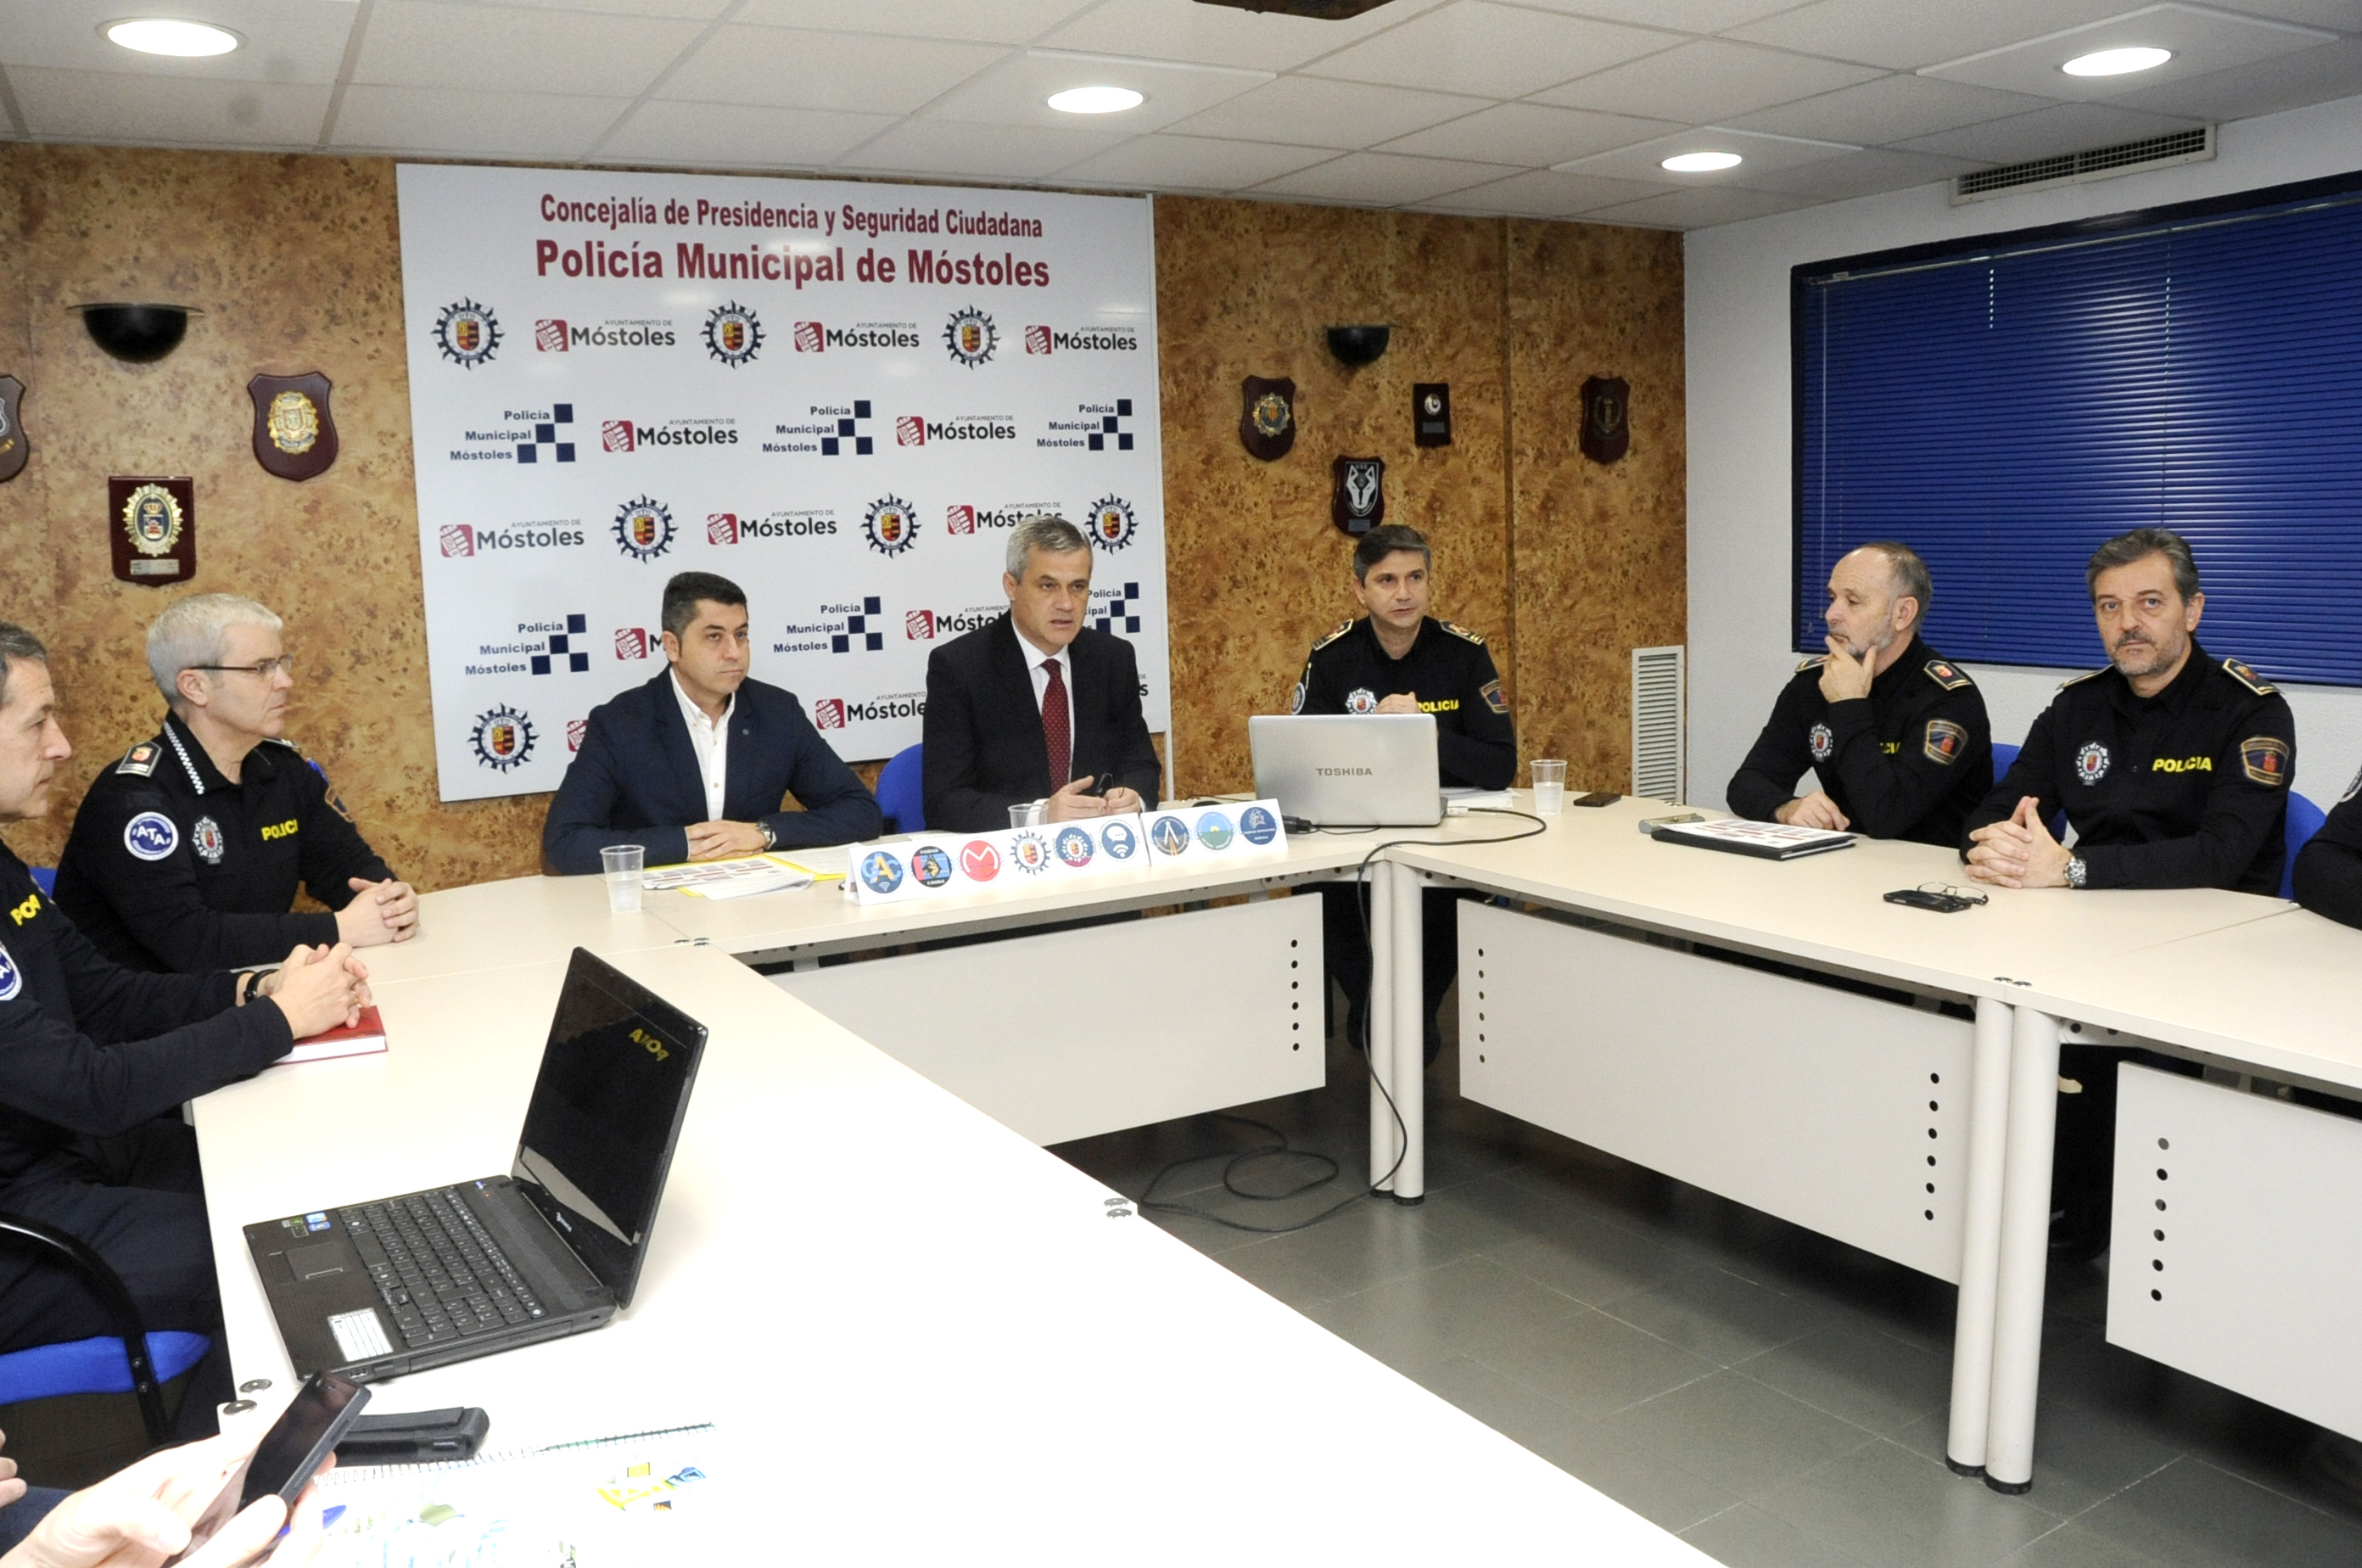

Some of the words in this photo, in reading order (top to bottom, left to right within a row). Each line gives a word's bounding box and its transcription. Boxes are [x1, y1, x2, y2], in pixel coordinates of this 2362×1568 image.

[540, 193, 658, 231] Concejalía
[663, 198, 690, 226] de
[697, 199, 819, 229] Presidencia
[824, 210, 836, 237] y
[842, 204, 940, 238] Seguridad
[945, 209, 1043, 238] Ciudadana
[535, 238, 663, 278] Policía
[676, 242, 844, 290] Municipal
[856, 247, 896, 283] de
[907, 249, 1049, 288] Móstoles
[570, 326, 676, 346] Móstoles
[826, 328, 920, 348] Móstoles
[1053, 332, 1138, 351] Móstoles
[809, 406, 851, 416] Policía
[1078, 404, 1115, 413] Policía
[503, 410, 551, 421] Policía
[775, 423, 835, 436] Municipal
[926, 421, 1016, 440] Móstoles
[1048, 421, 1100, 432] Municipal
[465, 429, 532, 442] Municipal
[636, 425, 739, 446] Móstoles
[762, 442, 818, 453] Móstoles
[1036, 438, 1085, 447] Móstoles
[450, 449, 512, 461] Móstoles
[977, 509, 1063, 529] Móst
[739, 517, 838, 538] Móstoles
[476, 527, 585, 551] Móstoles
[820, 603, 861, 614] Policía
[518, 621, 564, 634] Policía
[786, 621, 845, 635] Municipal
[479, 641, 546, 655] Municipal
[773, 641, 828, 653] Móstoles
[465, 662, 527, 675] Móstoles
[847, 698, 926, 722] Móstole
[1316, 767, 1374, 776] TOSHIBA
